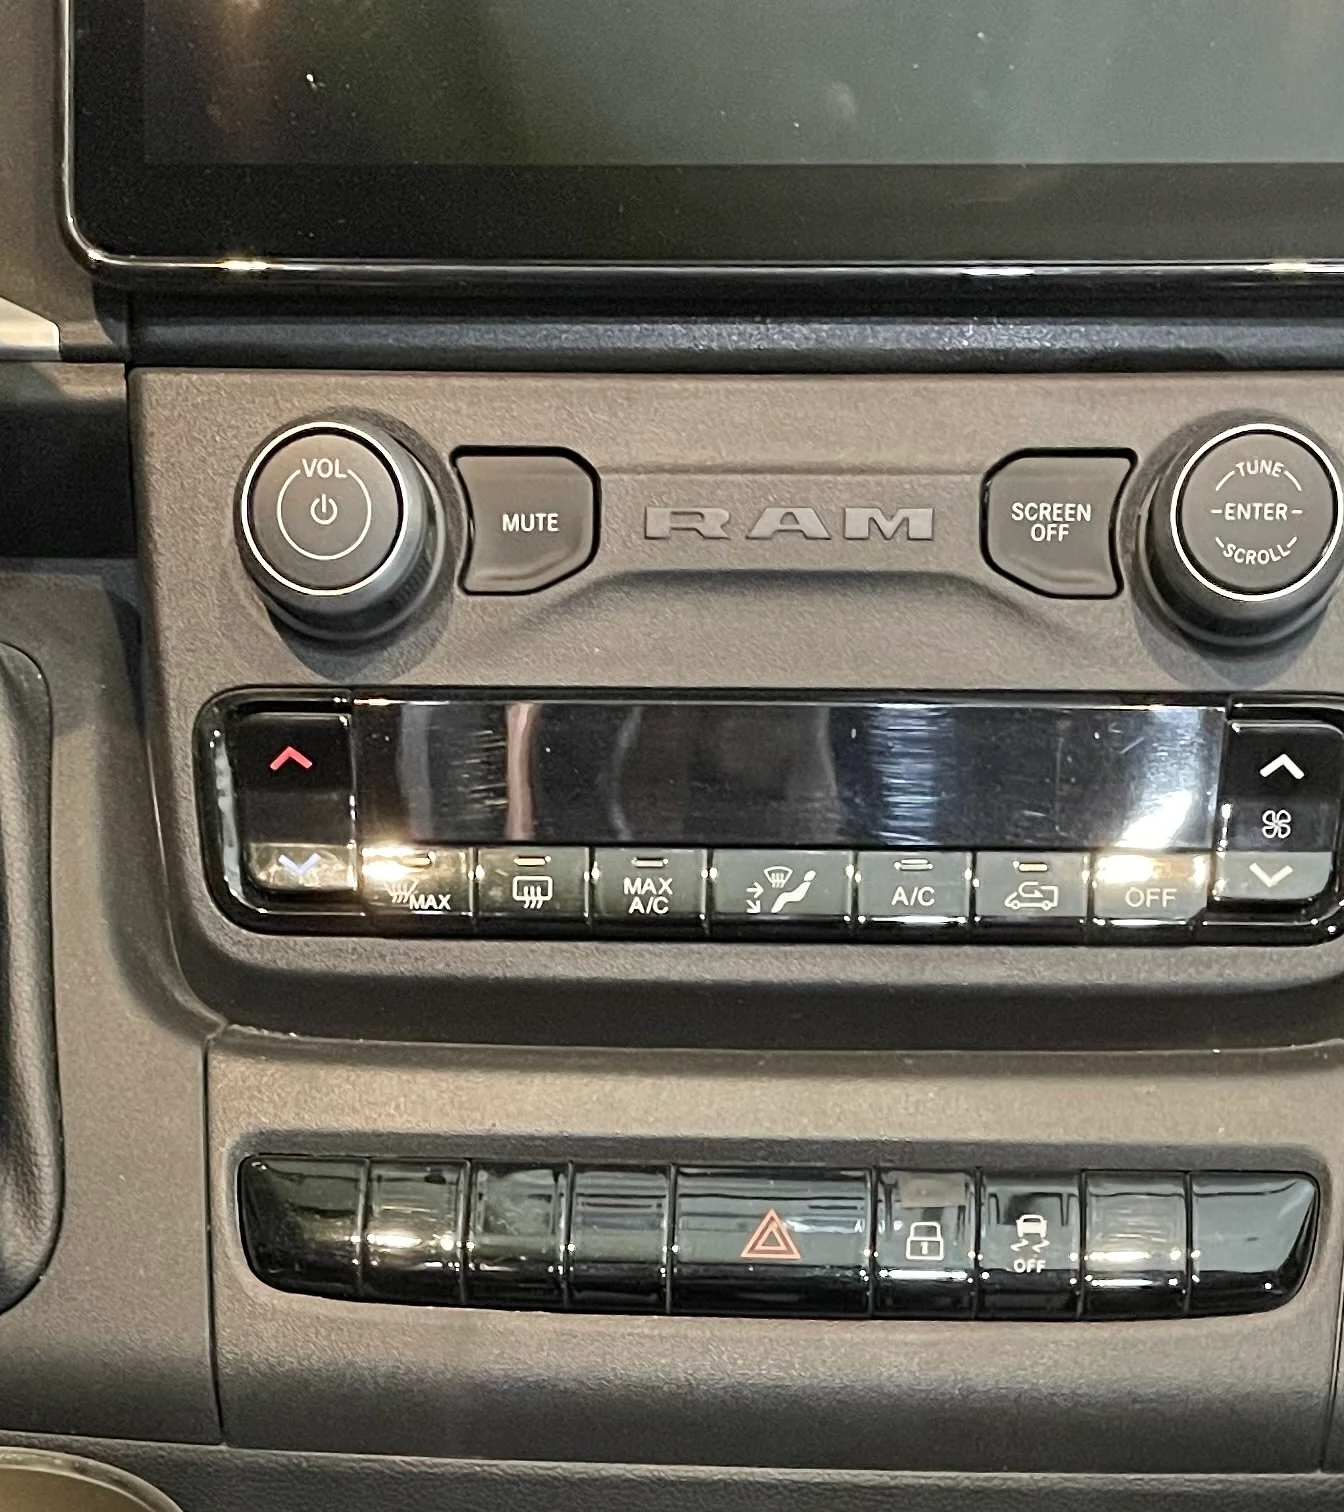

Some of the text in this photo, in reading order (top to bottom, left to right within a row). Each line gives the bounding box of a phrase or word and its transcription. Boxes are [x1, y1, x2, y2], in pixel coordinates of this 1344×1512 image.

[301, 458, 347, 478] VOL
[1235, 459, 1285, 477] TUNE
[1011, 503, 1092, 523] SCREEN
[1224, 502, 1288, 521] ENTER
[502, 513, 559, 532] MUTE
[644, 506, 934, 540] RAM
[1030, 524, 1069, 542] OFF
[1222, 543, 1291, 565] SCROLL
[623, 877, 674, 895] MAX
[409, 893, 452, 910] MAX
[628, 896, 669, 914] A/C
[891, 886, 936, 906] A/C
[1124, 887, 1177, 908] OFF
[1013, 1258, 1046, 1273] OFF
